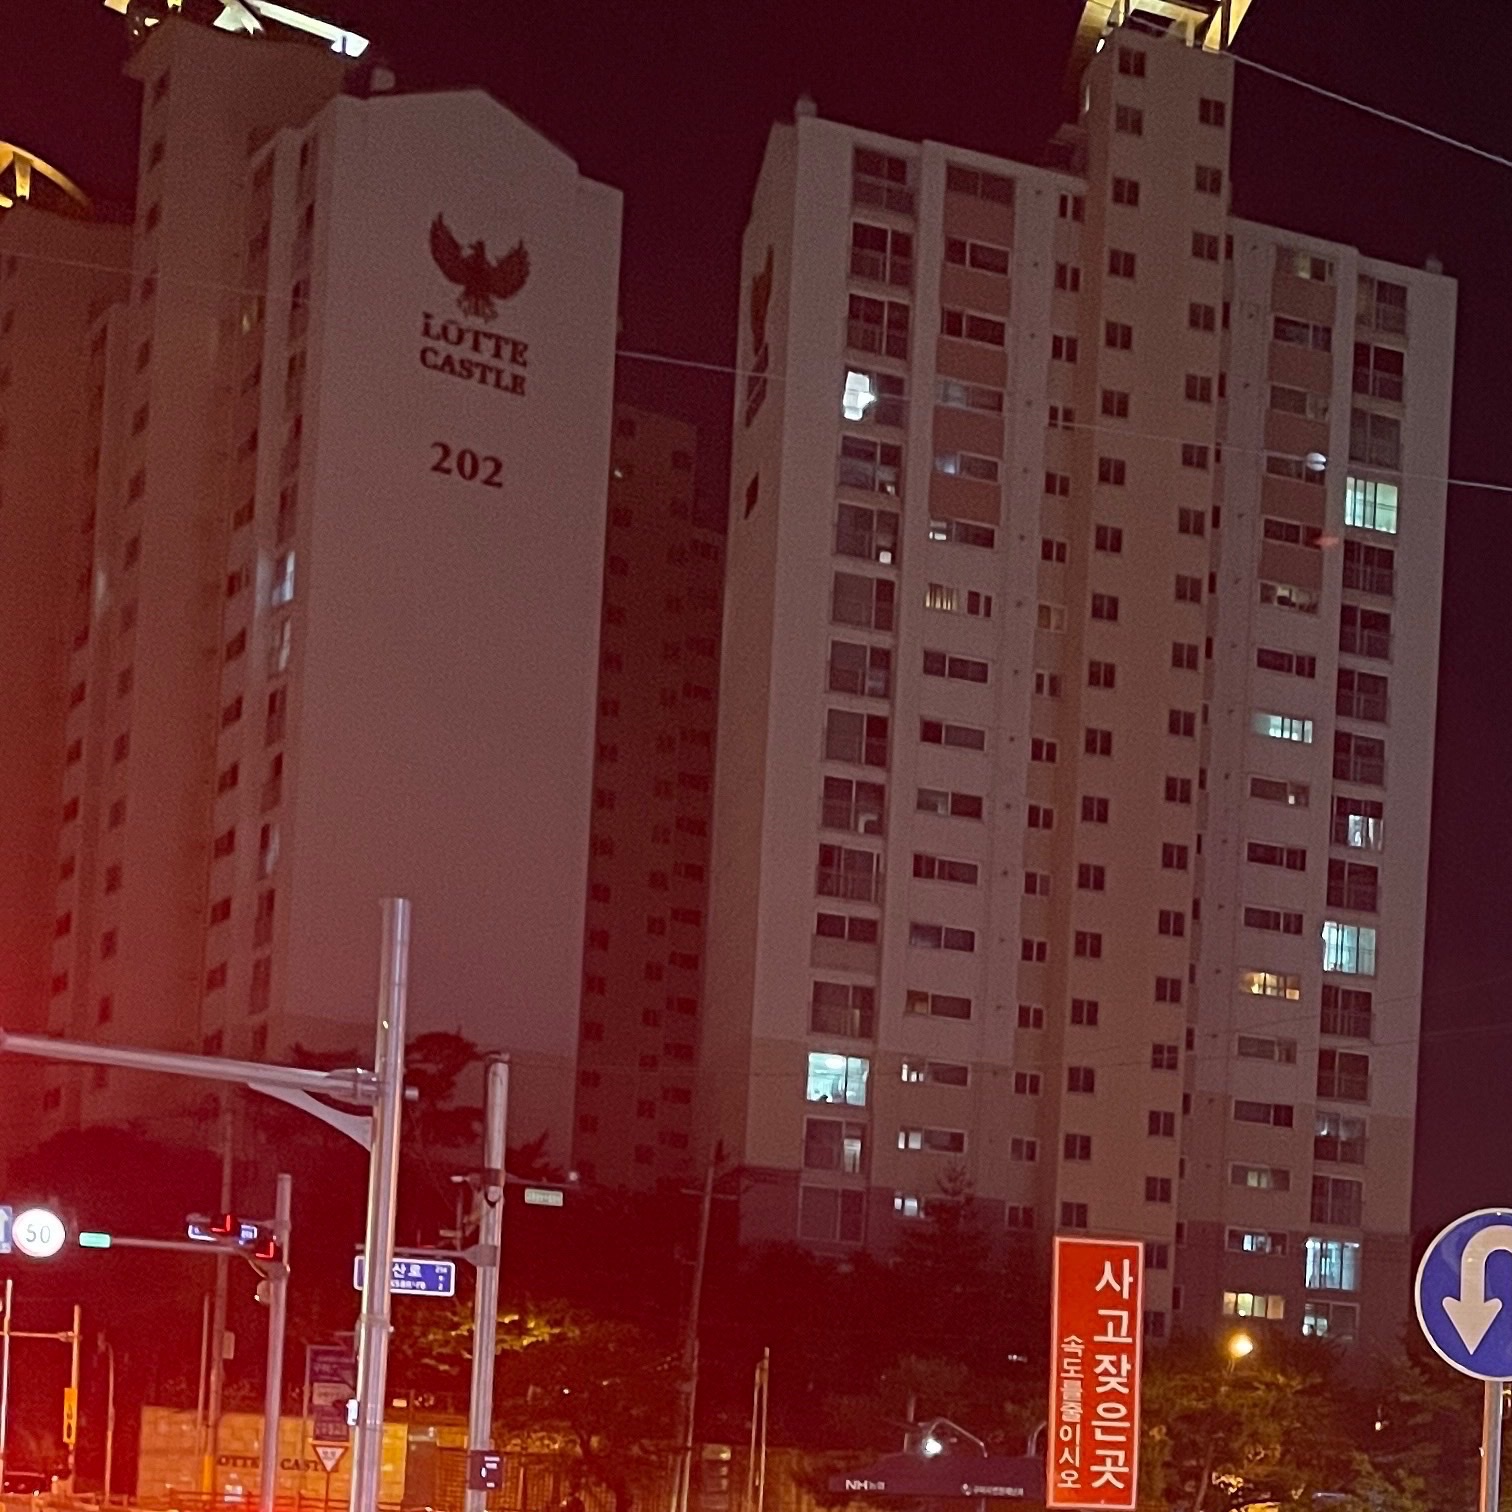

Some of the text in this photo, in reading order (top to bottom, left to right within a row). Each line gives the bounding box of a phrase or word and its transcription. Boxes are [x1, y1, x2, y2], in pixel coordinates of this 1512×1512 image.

[421, 311, 528, 367] LOTTE
[420, 346, 526, 397] CASTLE
[431, 442, 504, 488] 202
[26, 1224, 50, 1243] 50
[217, 1455, 260, 1469] OTTE
